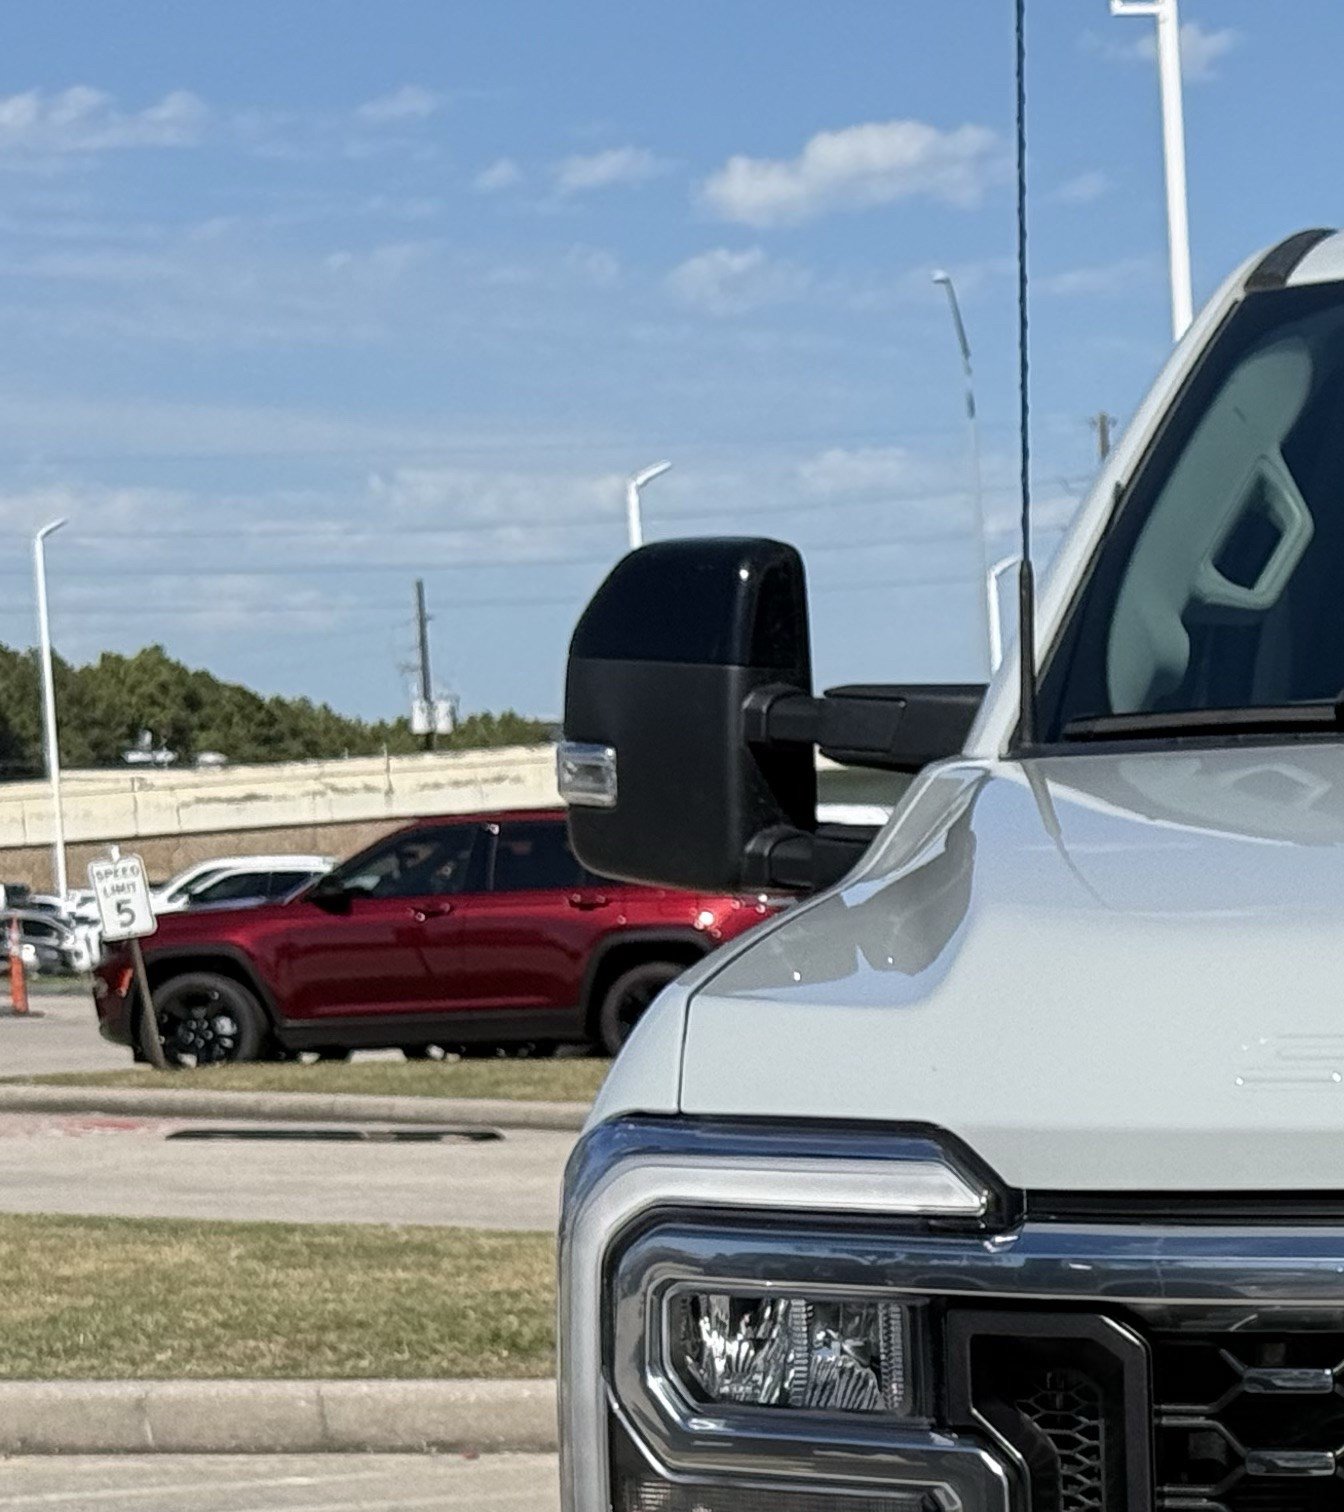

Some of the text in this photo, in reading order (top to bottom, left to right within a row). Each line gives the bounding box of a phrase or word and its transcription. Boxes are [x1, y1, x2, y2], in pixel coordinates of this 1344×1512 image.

[95, 864, 141, 880] SPEED
[102, 881, 137, 898] LIMIT
[116, 898, 136, 928] 5
